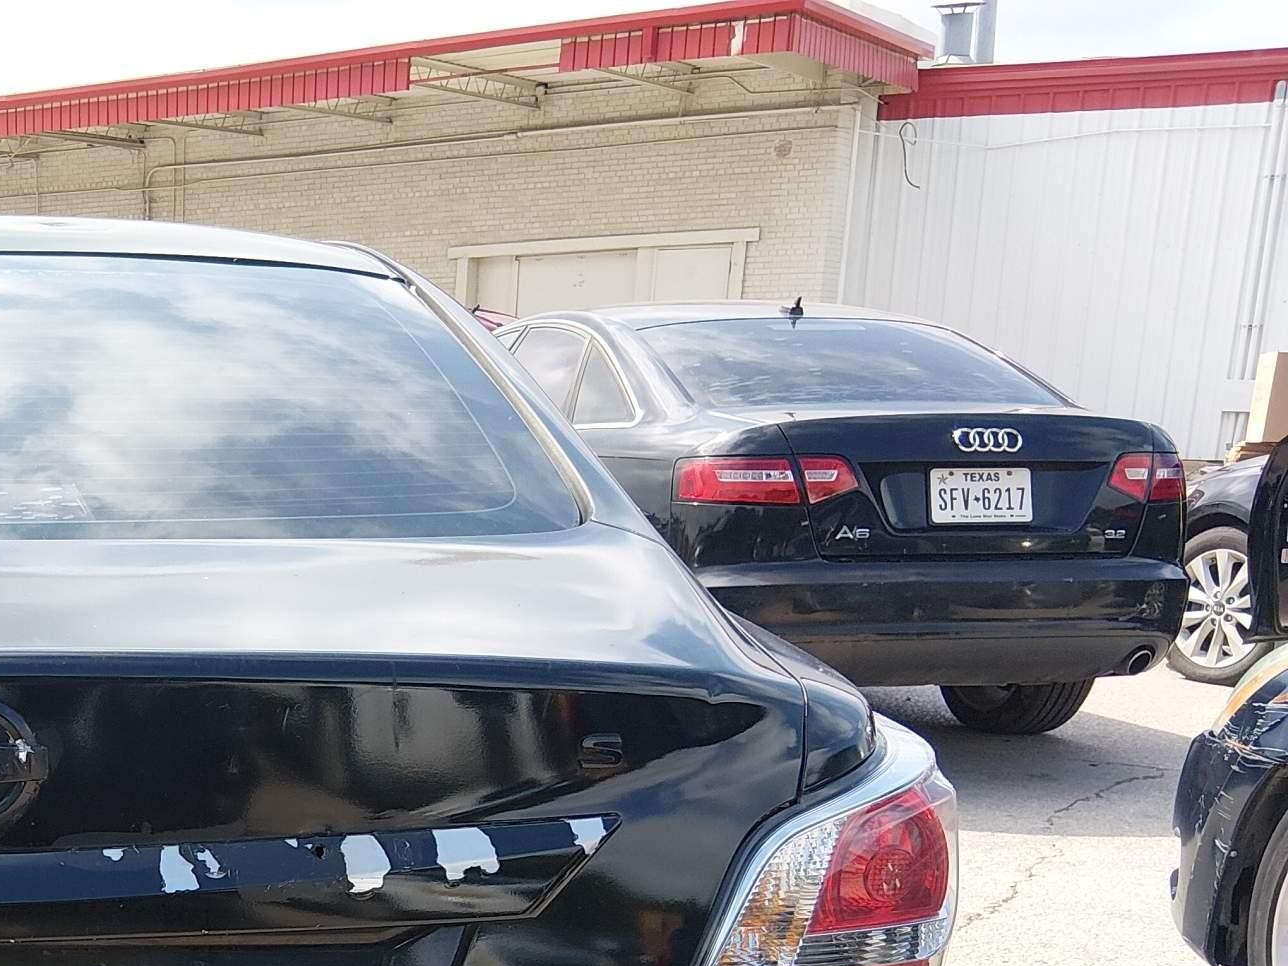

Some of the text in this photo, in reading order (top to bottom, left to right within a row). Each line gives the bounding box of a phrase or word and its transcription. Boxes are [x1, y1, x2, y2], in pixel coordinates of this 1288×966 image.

[962, 471, 1001, 482] TEXAS
[835, 525, 870, 540] A6
[580, 733, 623, 768] S
